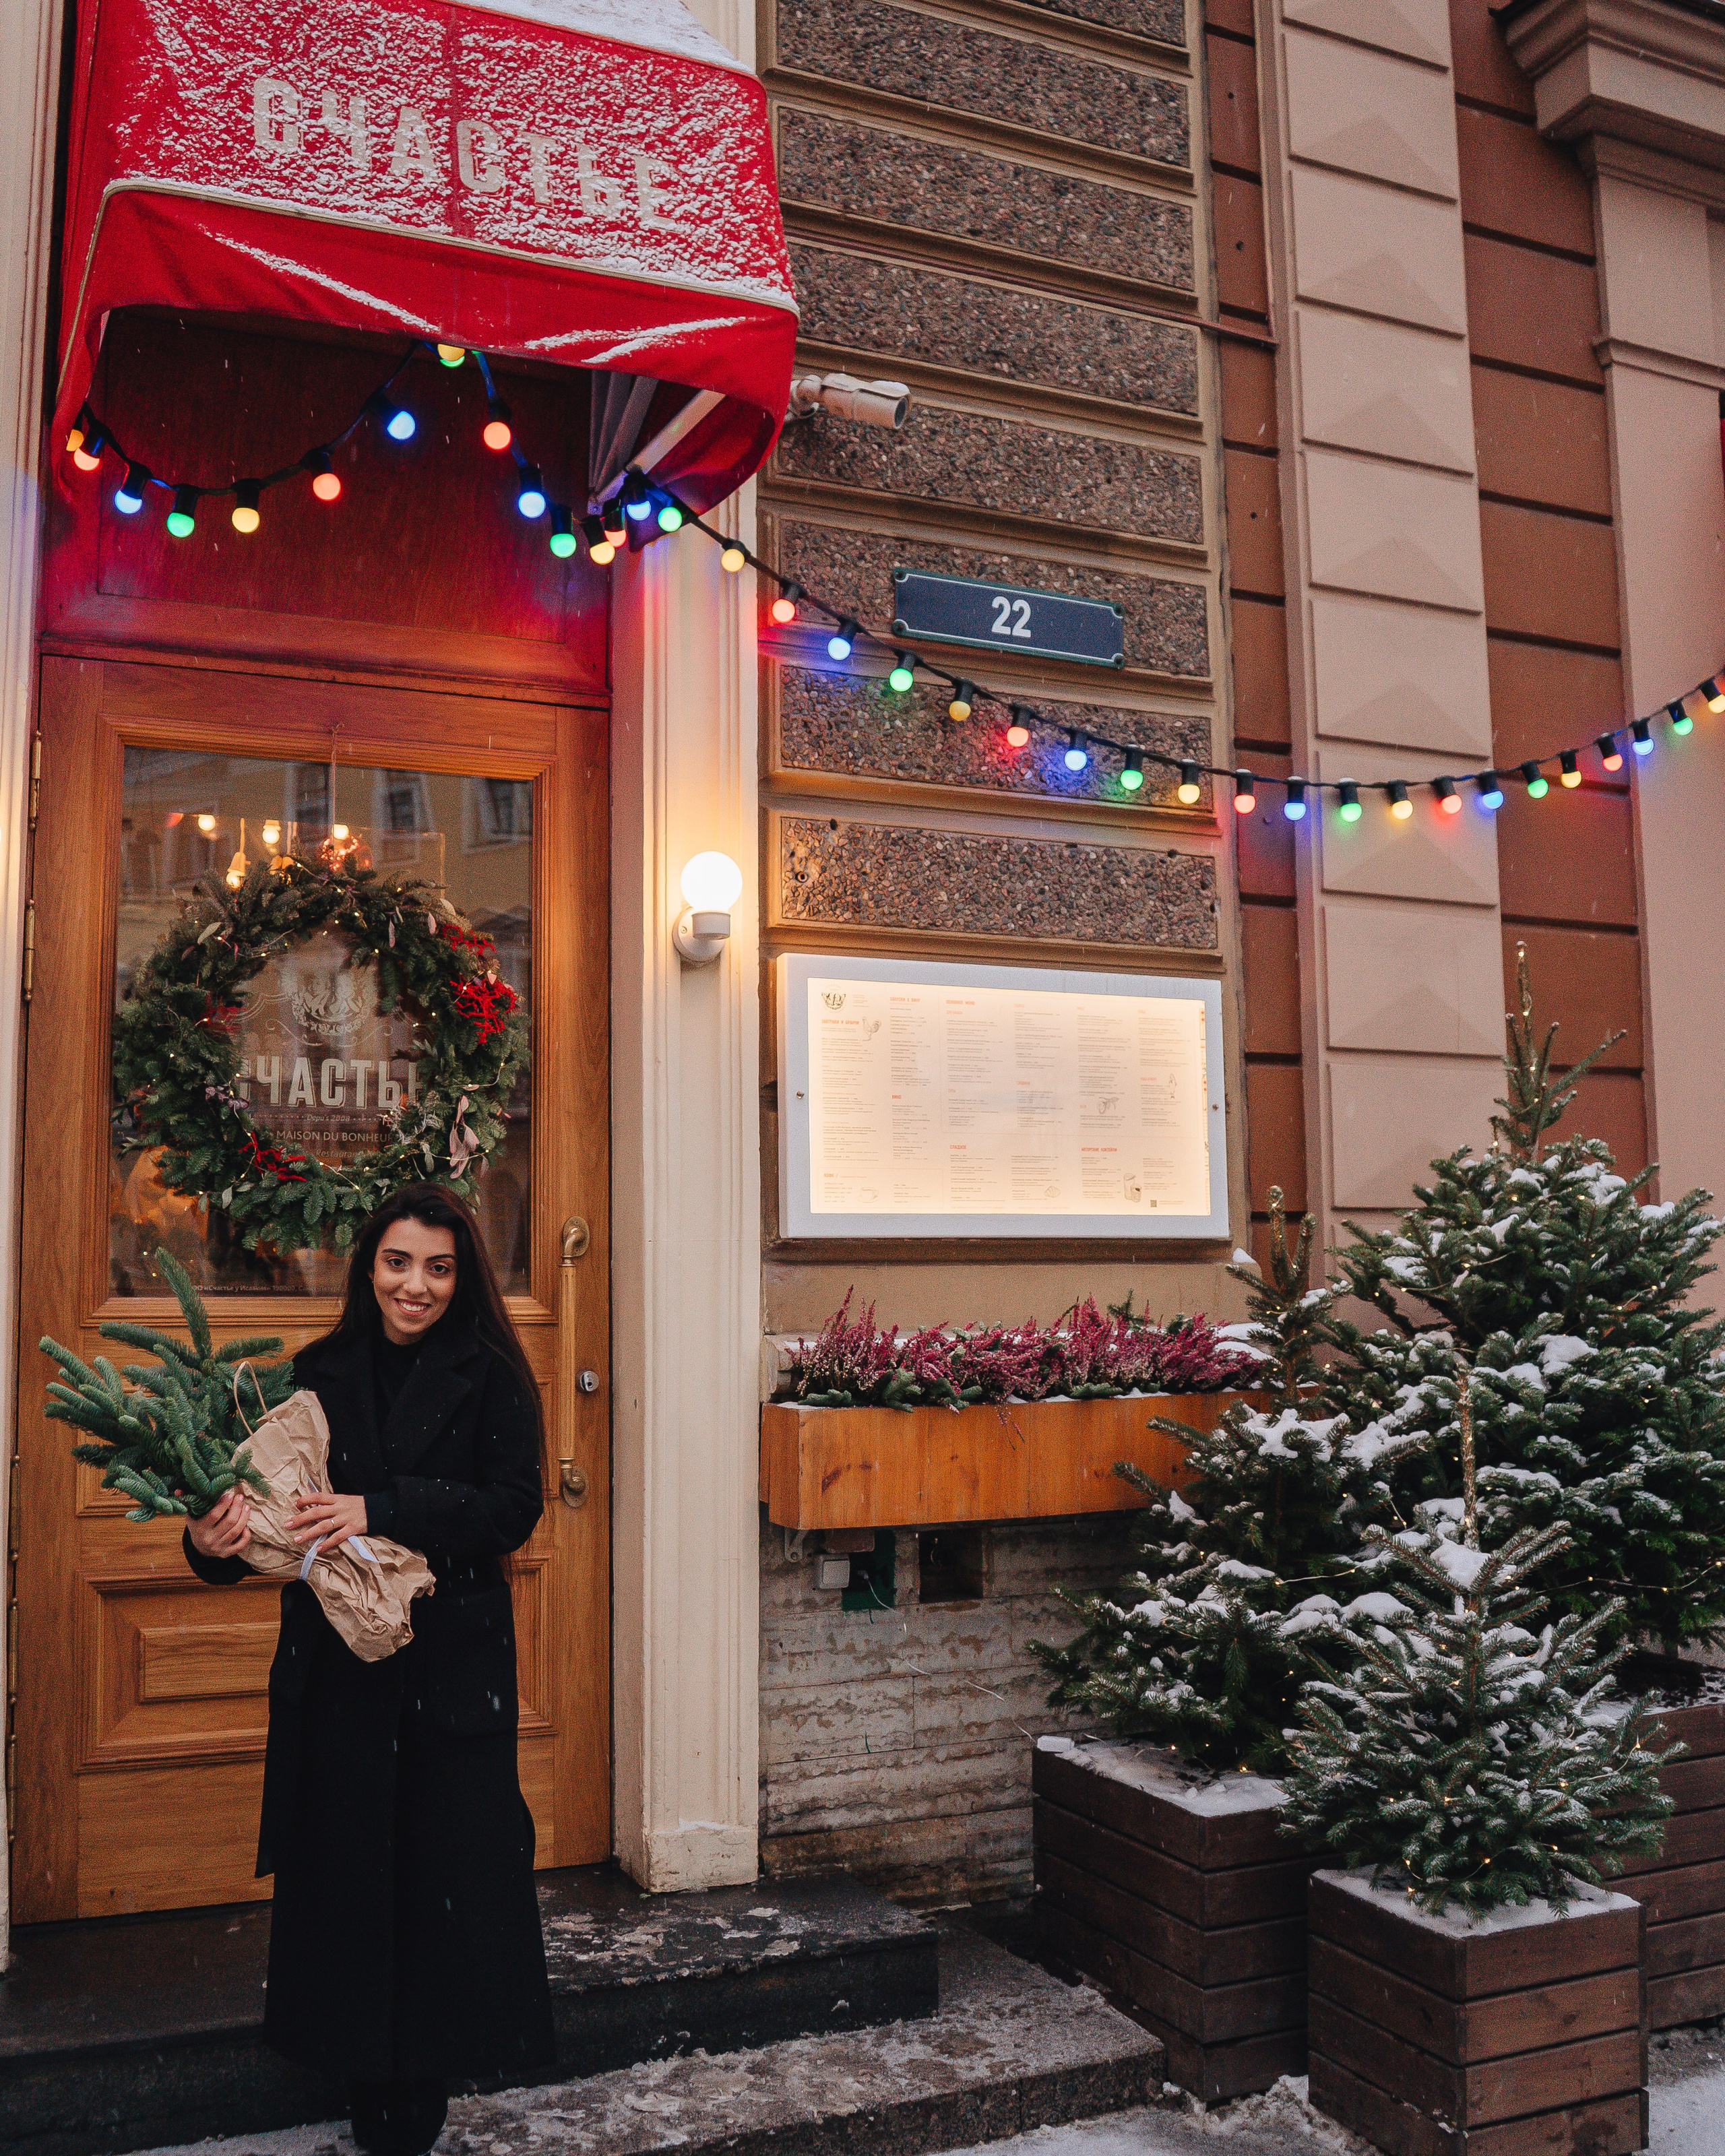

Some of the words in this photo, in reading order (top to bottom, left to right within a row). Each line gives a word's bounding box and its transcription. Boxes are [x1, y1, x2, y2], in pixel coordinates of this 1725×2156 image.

[253, 75, 678, 232] СЧАСТЬЕ
[991, 596, 1032, 637] 22
[276, 1131, 320, 1141] MAISON
[323, 1132, 338, 1141] DU
